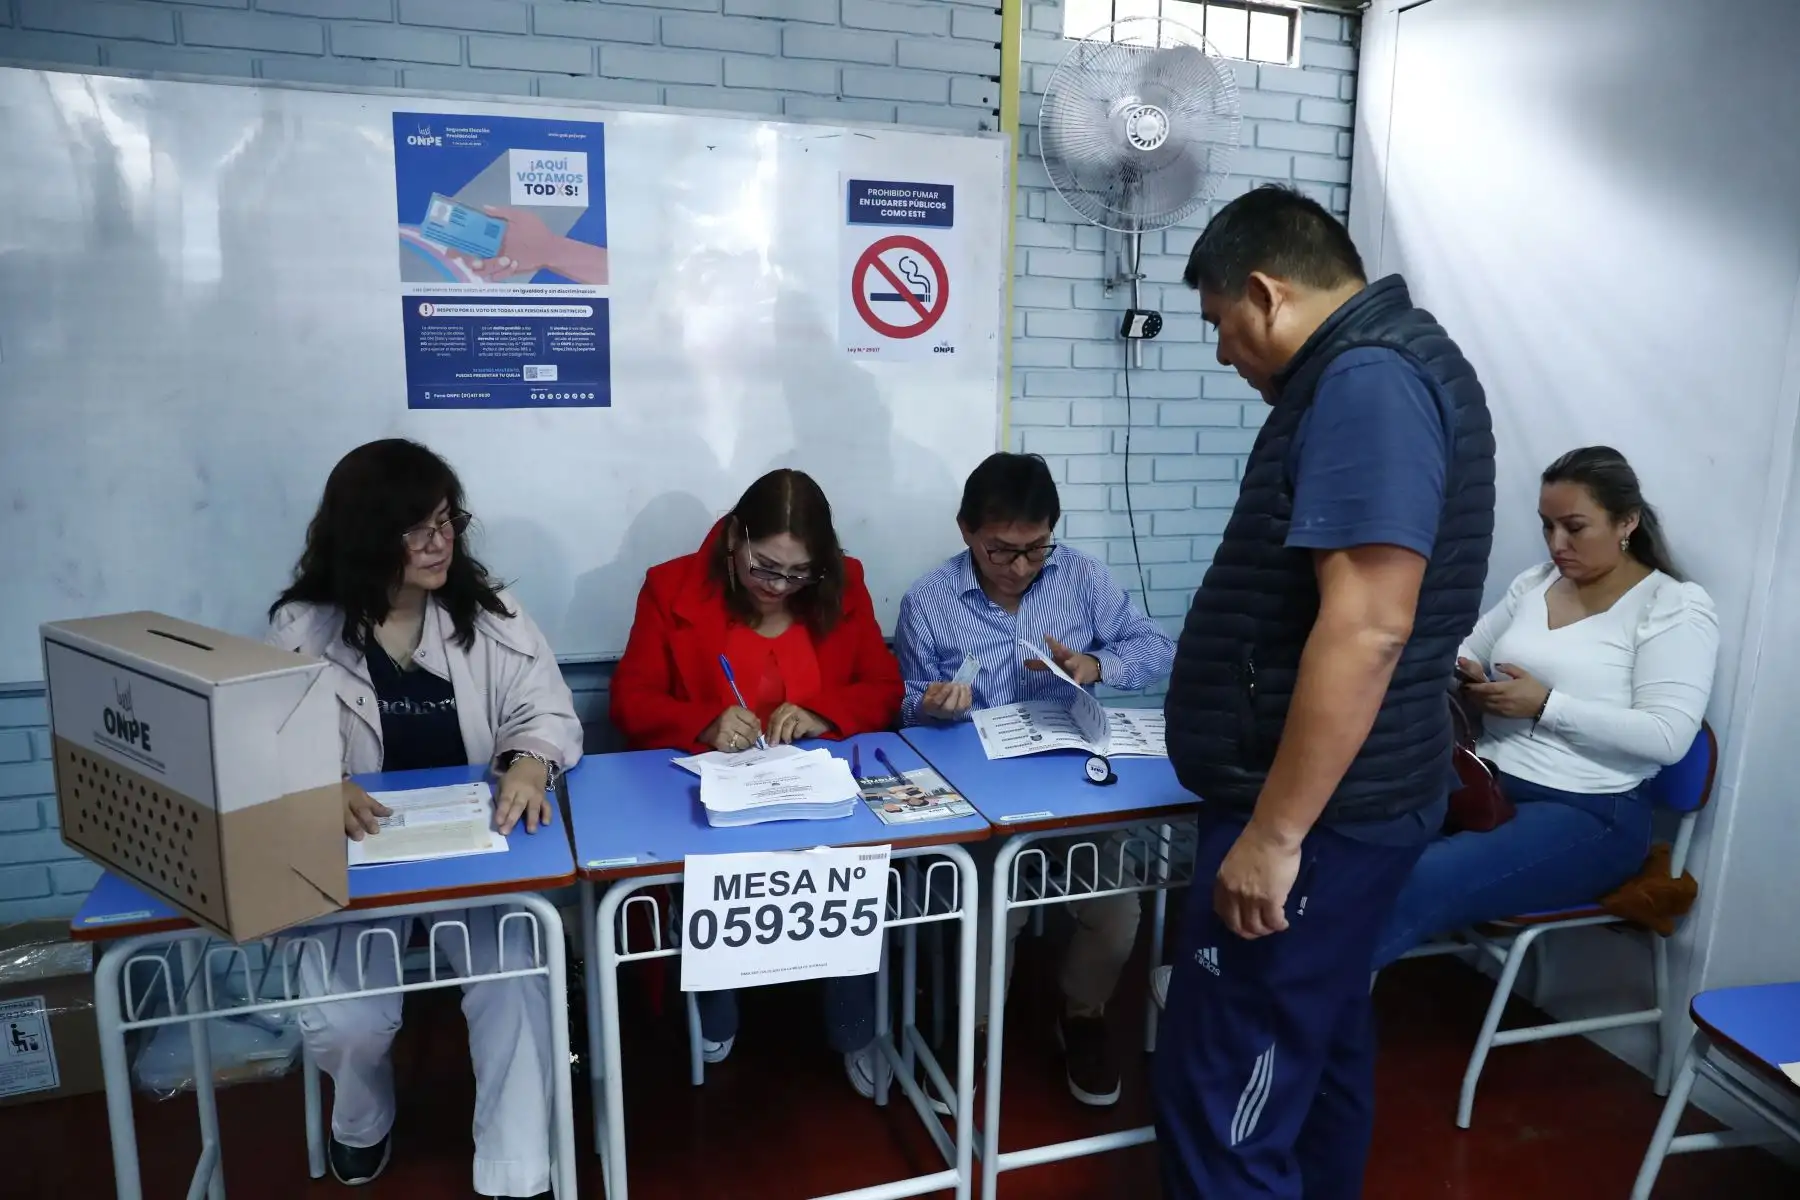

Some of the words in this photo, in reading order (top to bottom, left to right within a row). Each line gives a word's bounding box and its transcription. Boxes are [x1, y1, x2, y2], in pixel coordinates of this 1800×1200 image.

[407, 136, 442, 147] ONPE
[530, 157, 568, 172] ¡AQUÍ
[517, 171, 583, 184] VOTAMOS
[867, 188, 911, 198] PROHIBIDO
[912, 191, 939, 199] FUMAR
[859, 198, 870, 206] EN
[871, 199, 908, 207] LUGARES
[908, 199, 947, 209] PÚBLICOS
[880, 209, 907, 217] COMO
[933, 346, 955, 354] ONPE
[103, 706, 152, 752] ONPE
[713, 869, 817, 901] MESA
[689, 897, 879, 950] 059355
